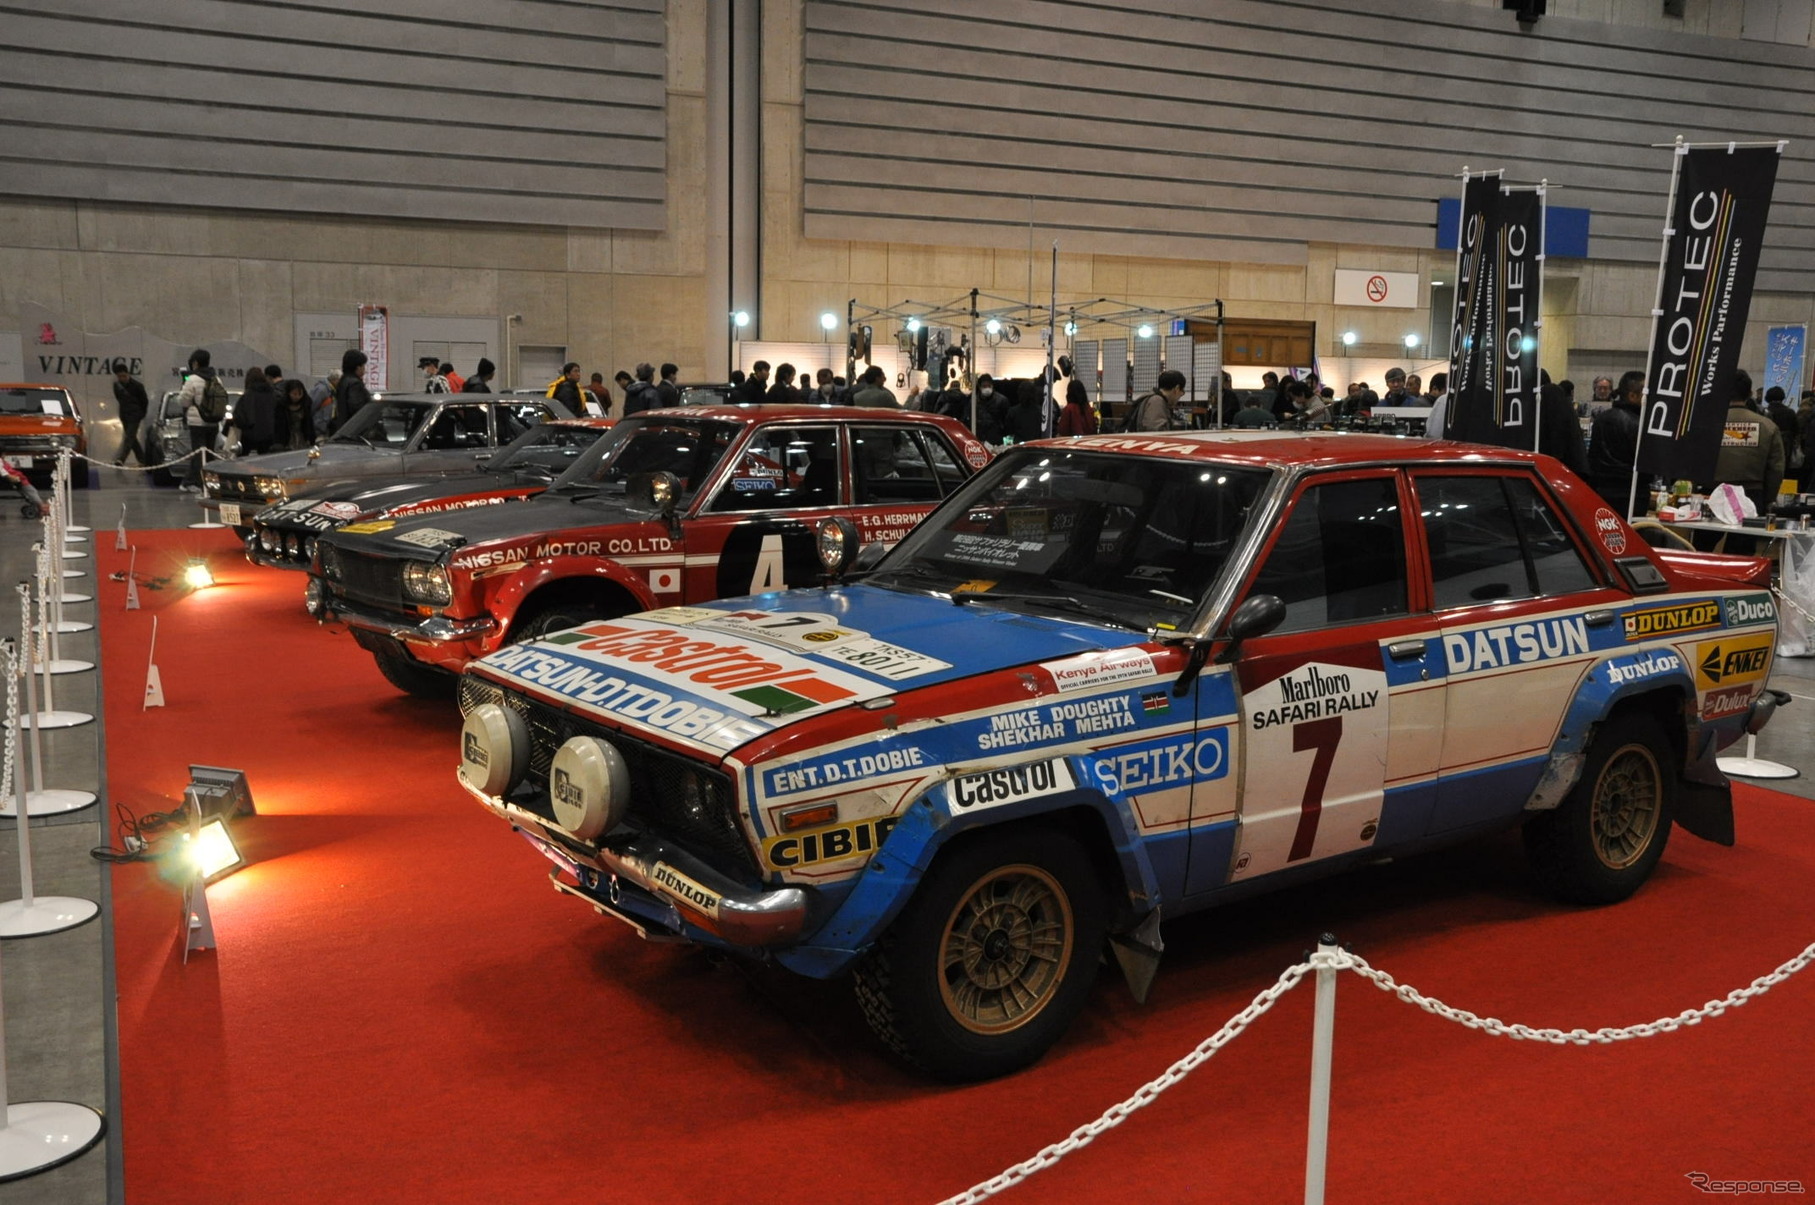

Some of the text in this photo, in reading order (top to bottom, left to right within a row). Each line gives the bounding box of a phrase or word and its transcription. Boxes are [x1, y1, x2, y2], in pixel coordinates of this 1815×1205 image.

[1647, 190, 1719, 437] PROTEC
[1701, 237, 1742, 396] Works Parformance
[1598, 518, 1619, 531] NGK
[458, 545, 528, 569] NISSAN
[536, 541, 601, 557] MOTOR
[749, 534, 788, 595] 4
[1638, 605, 1718, 632] DUNLOP
[1738, 600, 1773, 621] Duco
[577, 629, 817, 690] Castrol
[846, 650, 921, 677] 8011
[1443, 618, 1589, 674] DATSUN
[1722, 647, 1769, 677] ENKEI
[1054, 657, 1151, 681] Kenya Airways
[1060, 681, 1079, 691] OFFICIAL
[1100, 675, 1109, 683] FOR
[1279, 666, 1350, 704] Marlboro
[1608, 655, 1680, 684] DUNLOP
[991, 695, 1131, 732] MIKE DOUGHTY
[1253, 690, 1379, 730] SAFARI RALLY
[1713, 691, 1751, 714] Dulux
[978, 711, 1135, 749] SHEKHAR MEHTA
[955, 758, 1057, 807] Castrol
[1096, 738, 1222, 797] SEIKO
[1287, 716, 1343, 863] 7
[654, 866, 717, 911] DUNLOP
